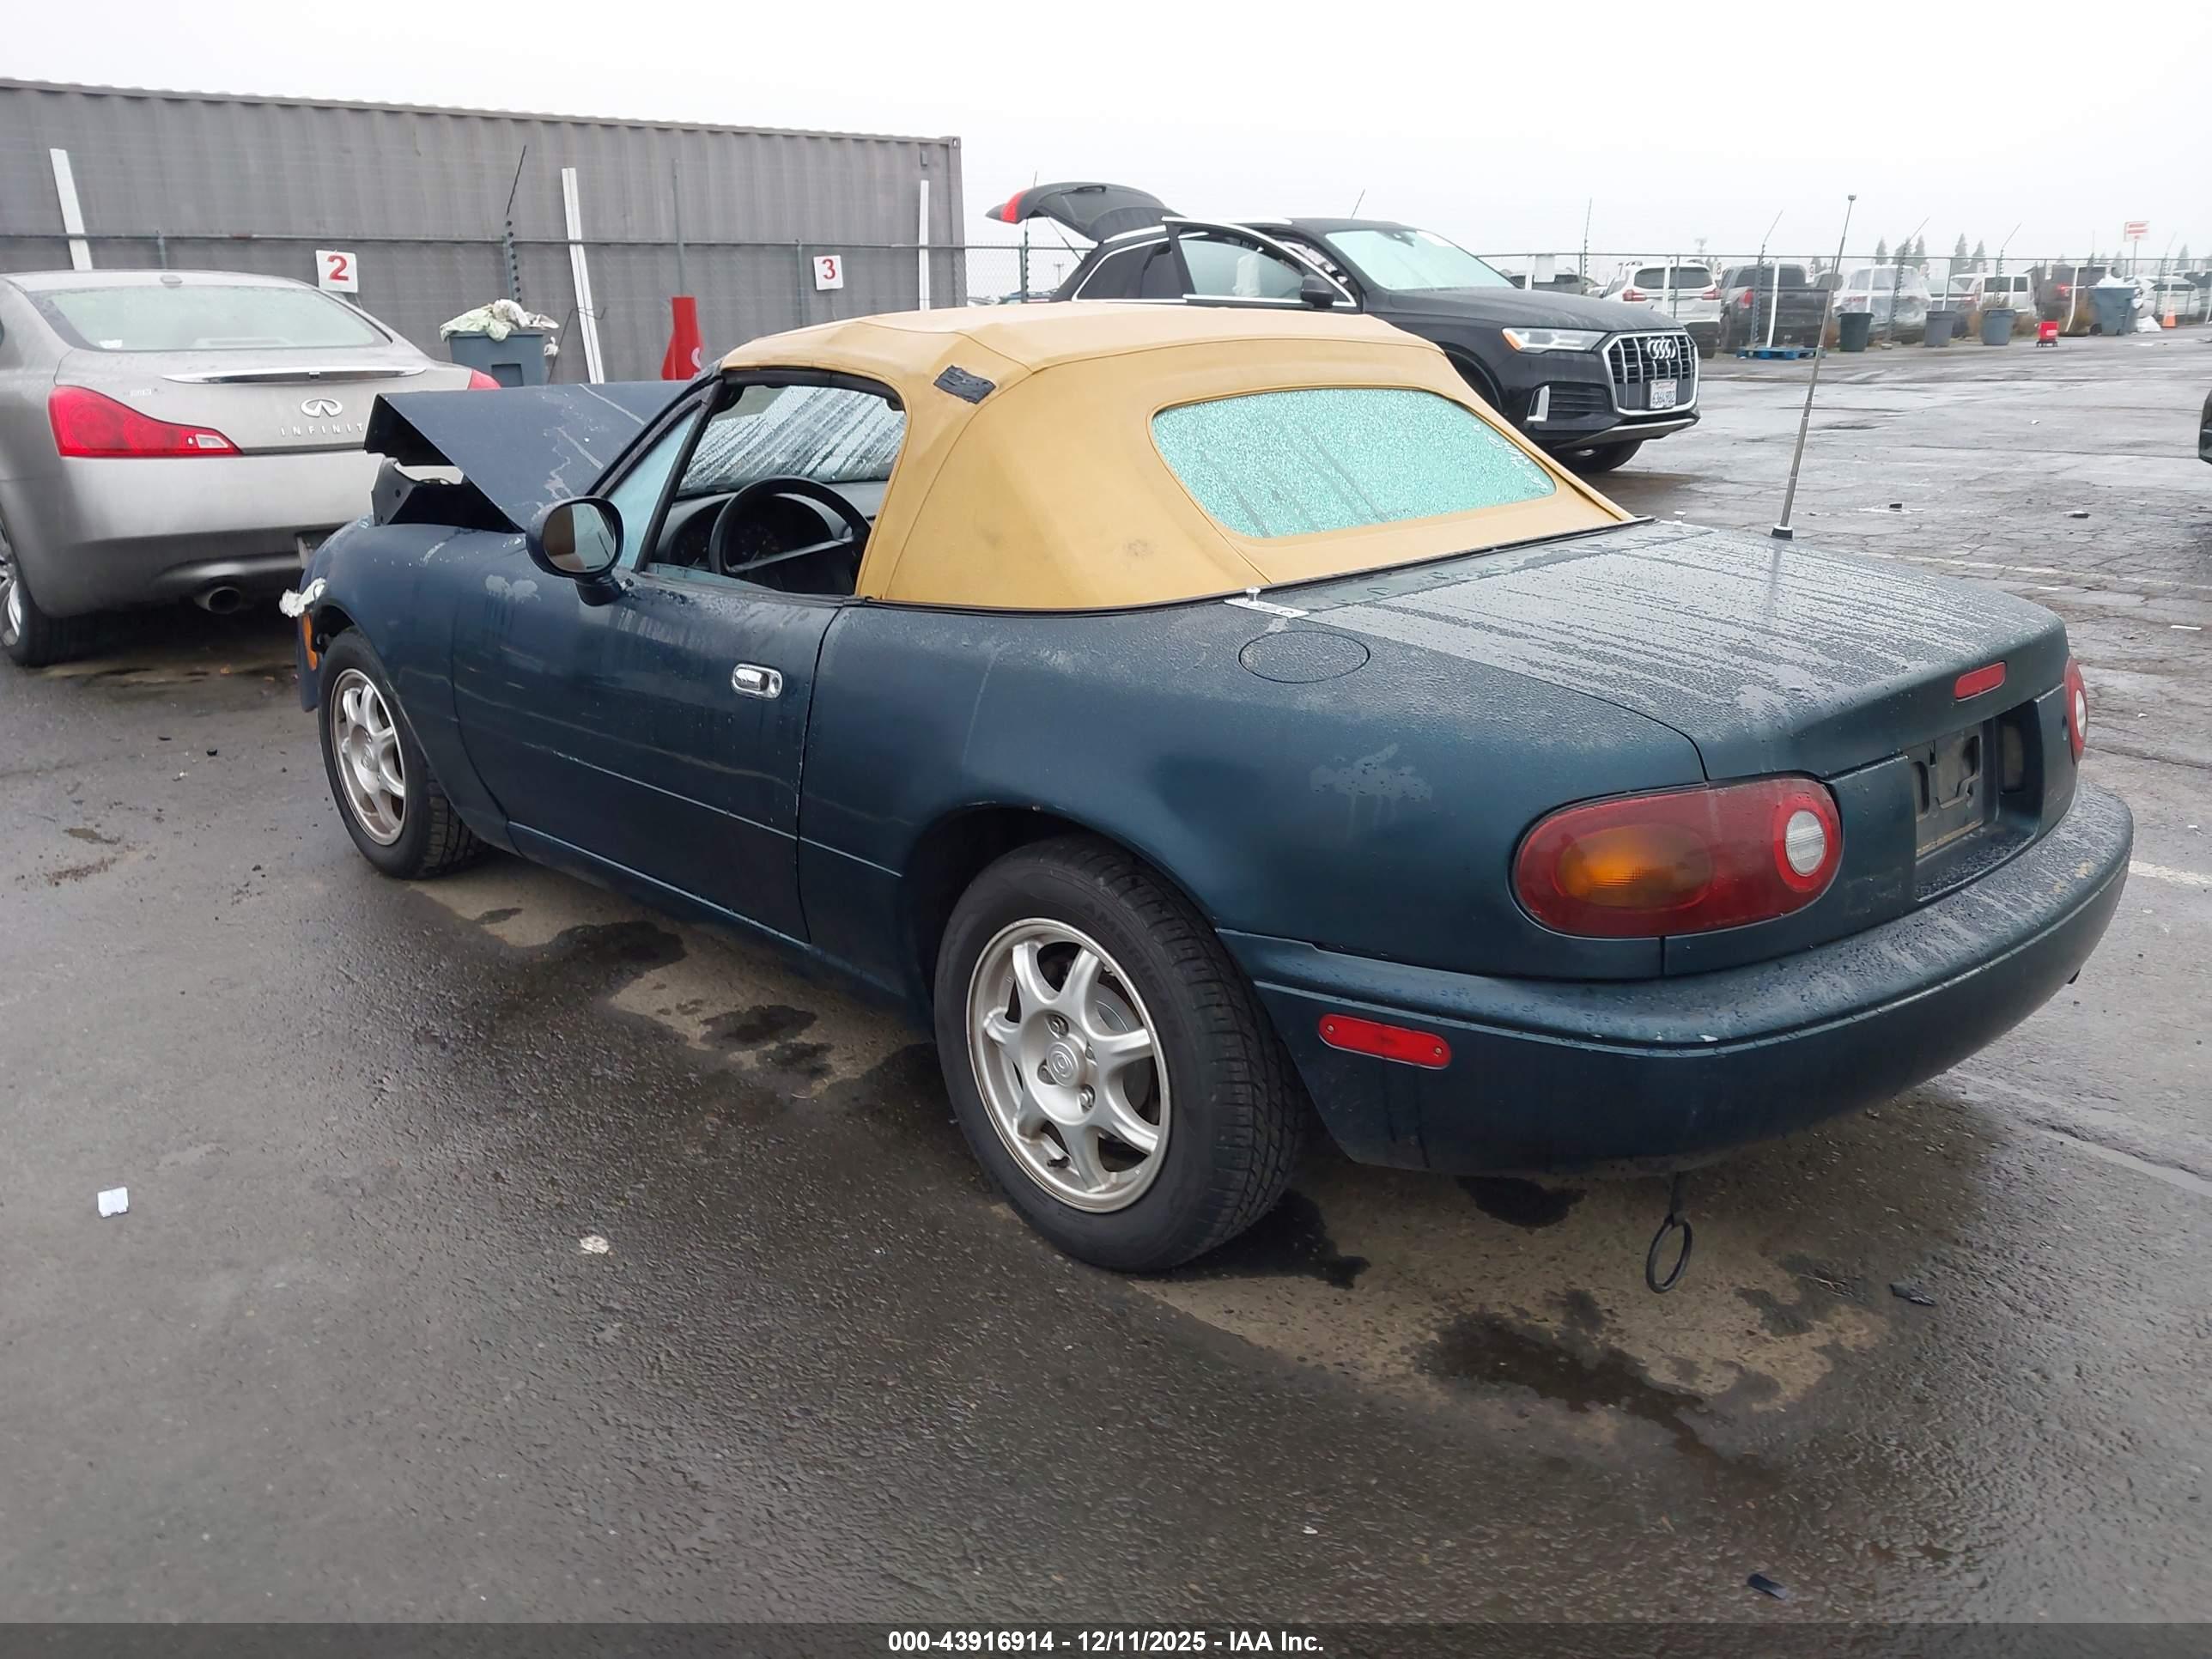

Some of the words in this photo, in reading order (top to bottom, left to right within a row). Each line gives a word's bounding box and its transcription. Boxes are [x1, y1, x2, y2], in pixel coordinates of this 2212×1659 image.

[327, 255, 349, 281] 2
[823, 258, 836, 280] 3
[280, 422, 363, 436] INFINIT
